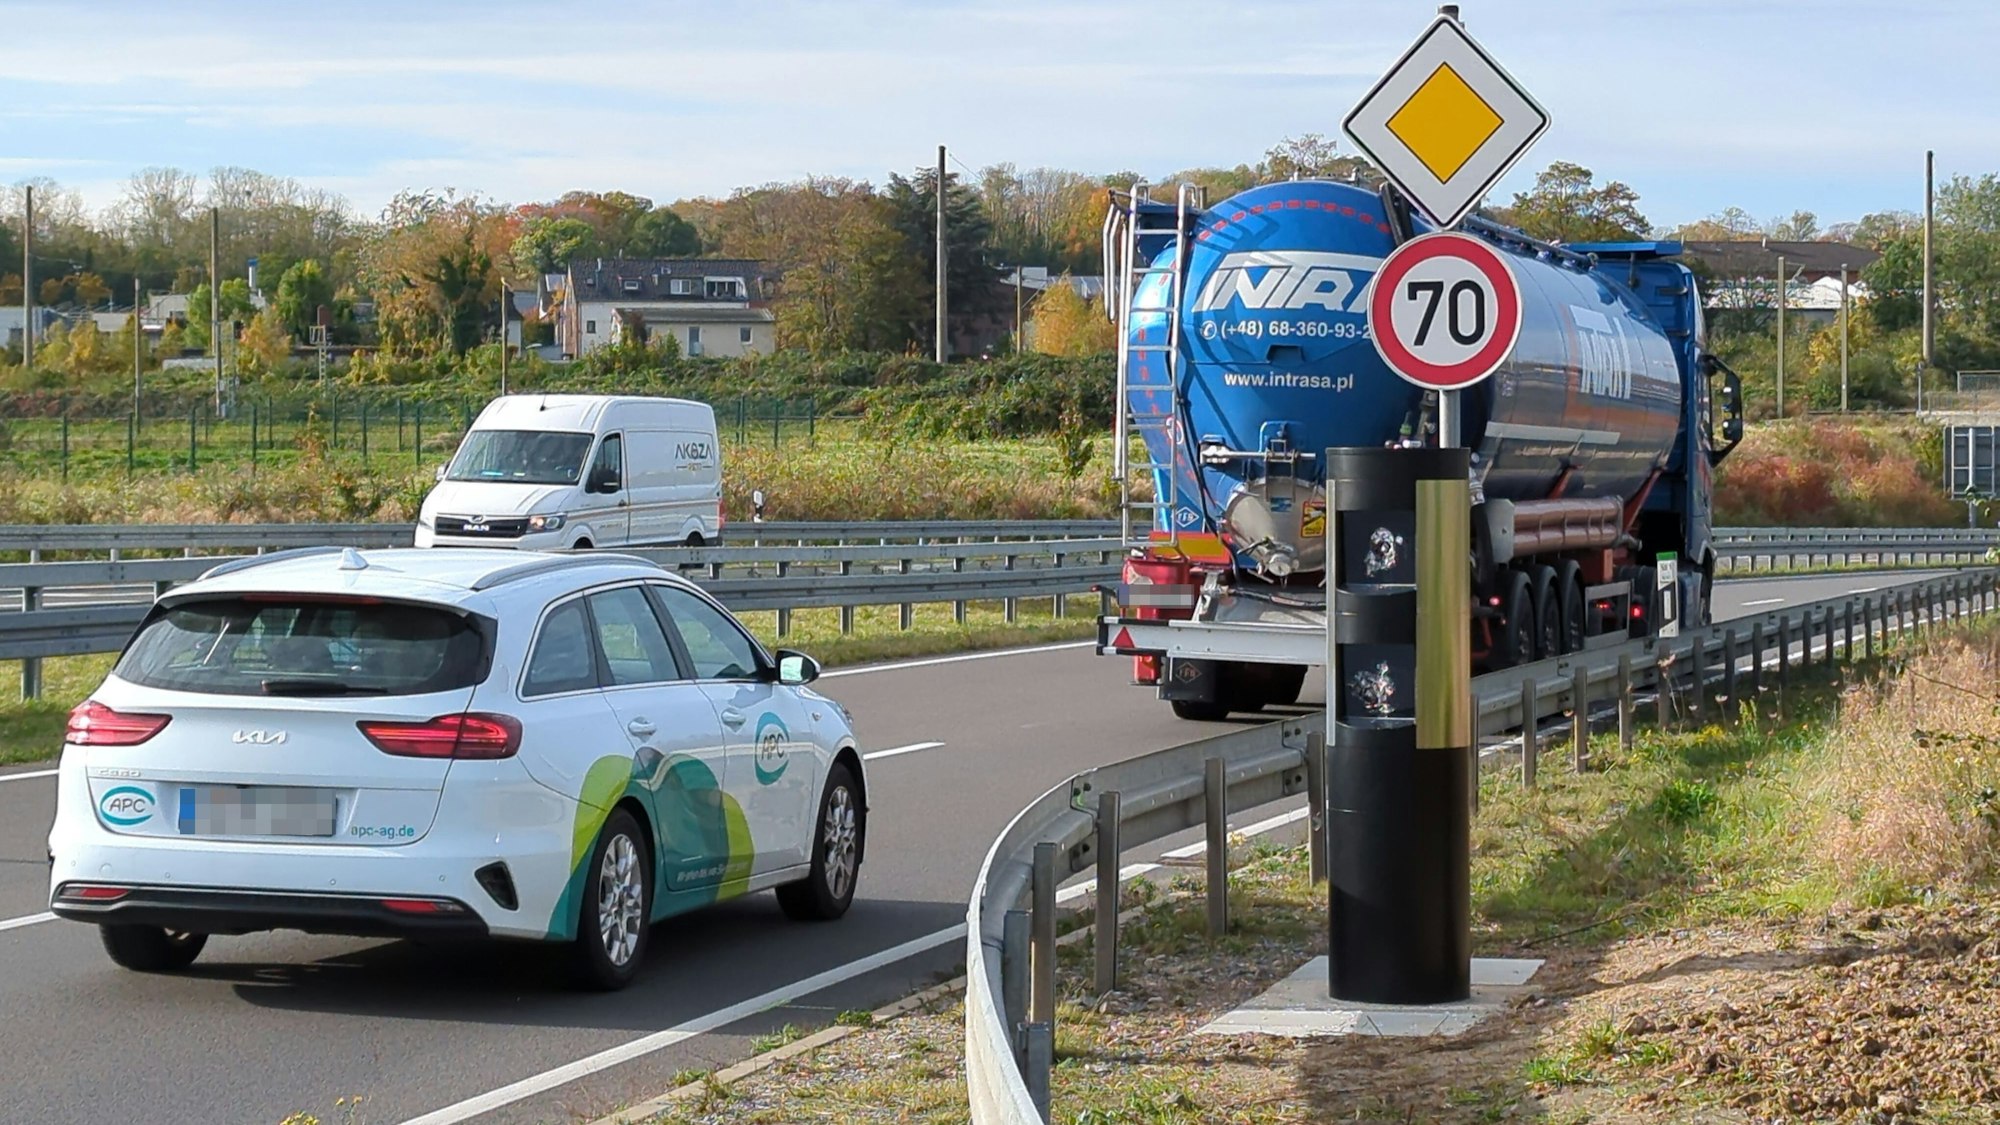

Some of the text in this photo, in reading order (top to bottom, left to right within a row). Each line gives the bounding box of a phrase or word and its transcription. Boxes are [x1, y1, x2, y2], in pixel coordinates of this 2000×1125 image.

[1408, 280, 1485, 346] 70
[1221, 320, 1372, 340] (+48) 68-360-93-2
[1224, 371, 1354, 392] www.intrasa.pl
[463, 523, 490, 532] MAN
[232, 730, 287, 744] KIA
[761, 733, 785, 760] APC
[109, 798, 146, 813] APC
[351, 825, 415, 839] apc-ag.de
